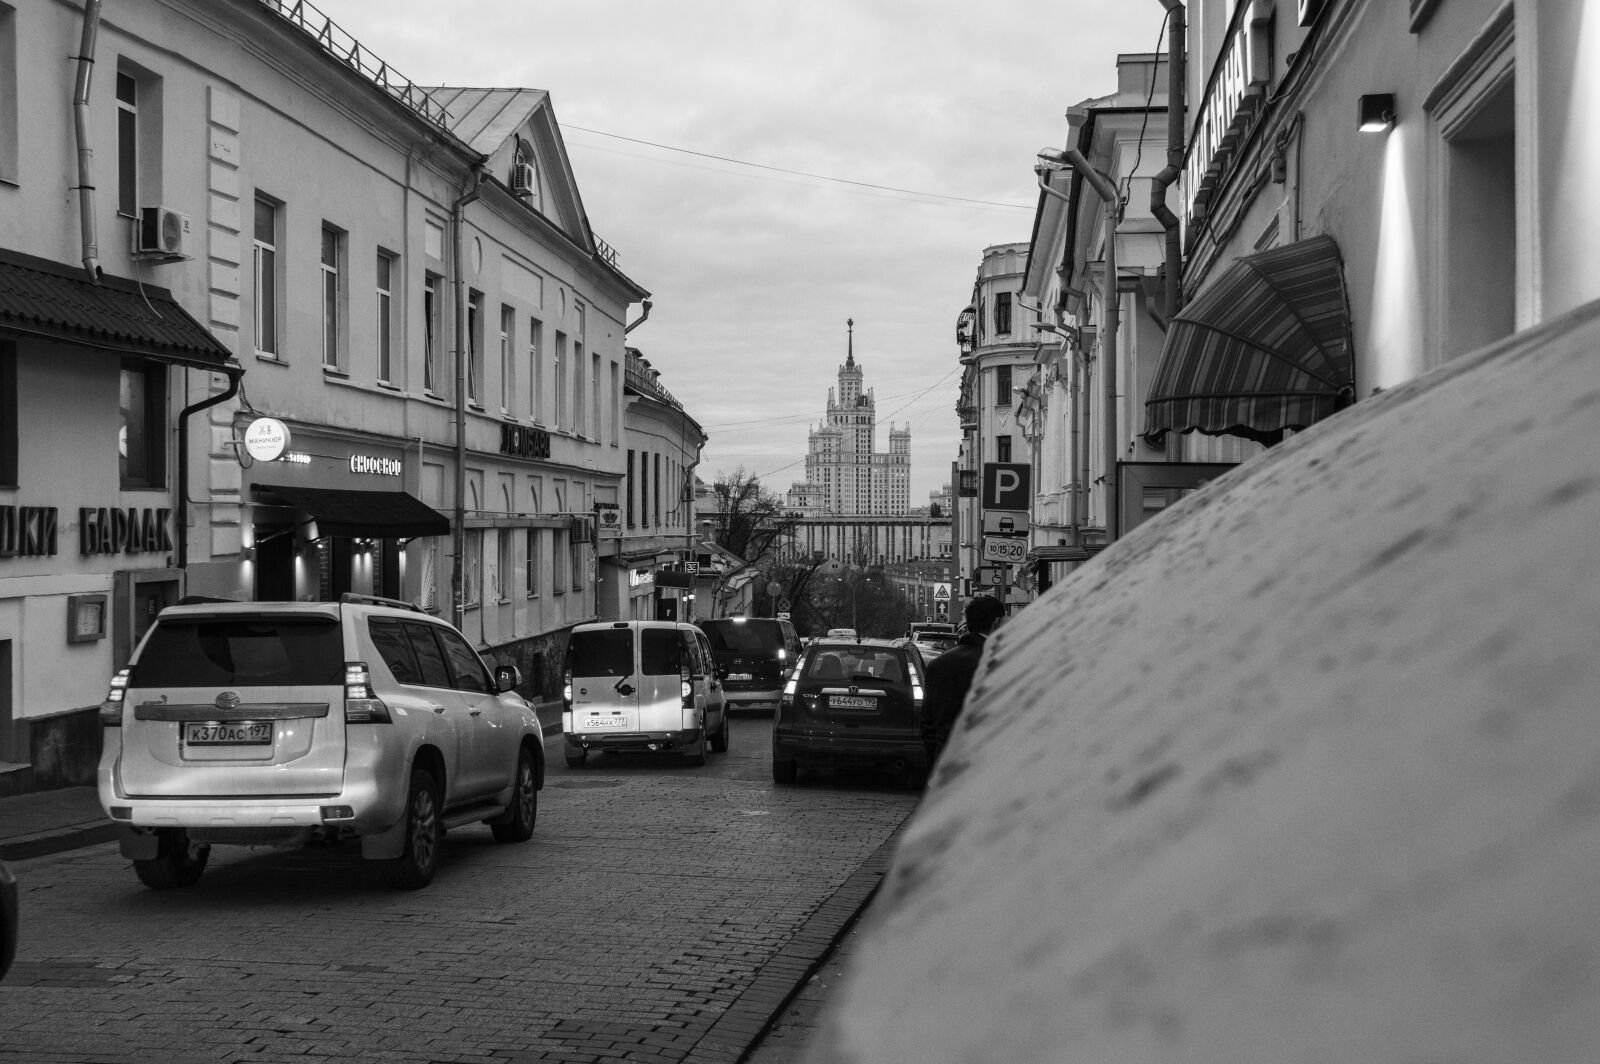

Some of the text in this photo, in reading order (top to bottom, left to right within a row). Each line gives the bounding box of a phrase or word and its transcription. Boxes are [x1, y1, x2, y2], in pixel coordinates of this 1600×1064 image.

[1187, 2, 1255, 228] ДЖАГАННАТ
[249, 436, 282, 444] МАНИКЮР
[995, 469, 1020, 504] P
[79, 507, 173, 554] БАРДАК
[990, 545, 1022, 556] 10 15 20
[192, 725, 268, 741] К370АС 197
